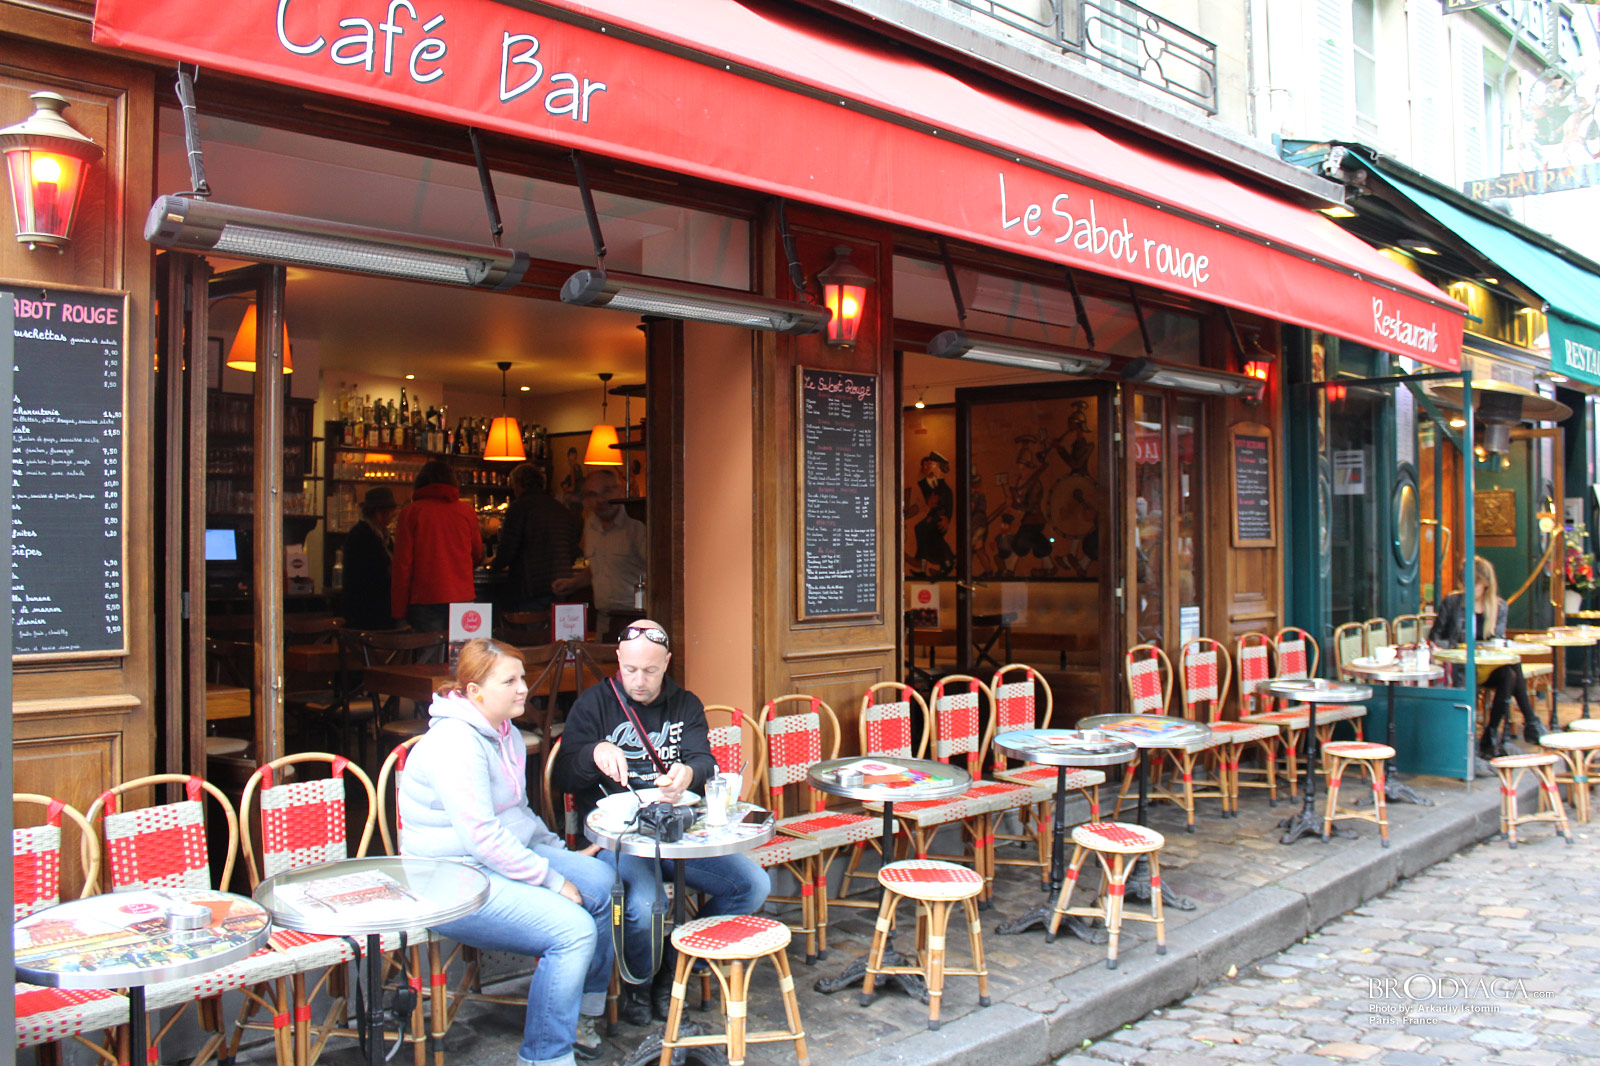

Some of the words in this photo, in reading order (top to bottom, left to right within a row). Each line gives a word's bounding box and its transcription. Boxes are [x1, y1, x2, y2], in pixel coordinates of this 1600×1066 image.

[276, 0, 447, 83] Café
[500, 31, 607, 122] Bar
[999, 173, 1042, 237] Le
[1052, 193, 1138, 263] Sabot
[1143, 239, 1210, 288] rouge
[62, 303, 119, 325] ROUGE
[1372, 297, 1438, 353] Restaurant
[818, 376, 843, 393] Sabot
[845, 379, 872, 401] Rouge
